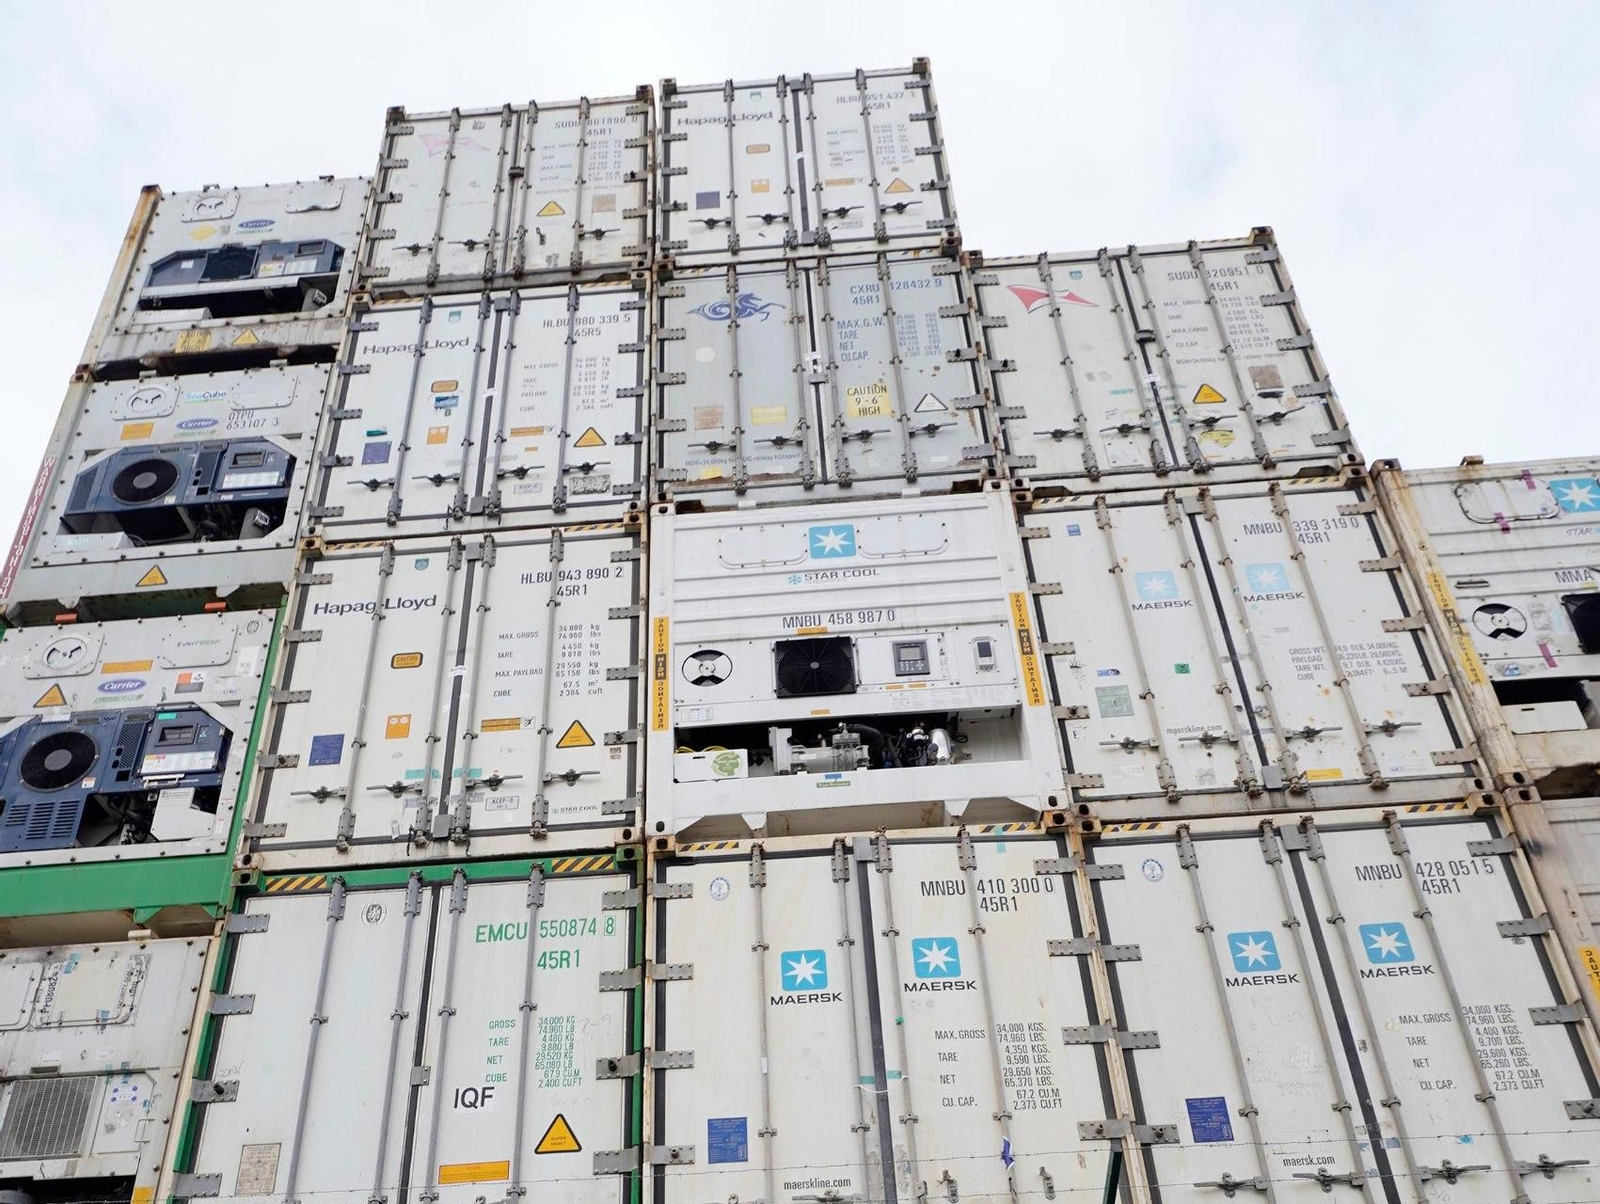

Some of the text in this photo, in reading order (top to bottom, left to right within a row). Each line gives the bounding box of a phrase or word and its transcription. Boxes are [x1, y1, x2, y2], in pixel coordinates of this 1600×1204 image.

[1167, 271, 1198, 281] SUDU
[850, 278, 942, 295] CXRU 128432 9
[1209, 281, 1240, 292] 45R1
[852, 295, 880, 305] 45R1
[543, 318, 570, 328] HLBU
[839, 330, 858, 340] TARE
[839, 341, 854, 351] NET
[847, 385, 887, 397] CAUTION
[858, 405, 880, 416] HIGH
[181, 420, 214, 428] Carrier
[226, 419, 266, 430] 653107
[1243, 517, 1347, 535] MNBU 339 319
[1298, 531, 1331, 544] 45R1
[521, 566, 623, 584] HLBU 943 890 2
[804, 568, 881, 582] STAR COOL
[556, 584, 587, 597] 45R1
[1243, 591, 1306, 602] MAERSK
[1132, 600, 1193, 611] MAERSK
[782, 609, 895, 630] MNBU 458 987 0
[104, 679, 141, 691] Carrier
[1355, 859, 1494, 881] MNBU 428 051 5
[920, 877, 1054, 896] MNBU 410 300 0
[1422, 878, 1460, 894] 45R1
[980, 896, 1018, 912] 45R1
[475, 917, 615, 943] EMCU 550874 8
[537, 949, 580, 970] 45R1
[1360, 964, 1435, 979] MAERSK
[1226, 972, 1300, 988] MAERSK
[904, 980, 977, 992] MAERSK
[770, 991, 843, 1006] MAERSK
[489, 1020, 516, 1030] GROSS
[566, 1016, 576, 1024] KG
[565, 1025, 575, 1033] LB
[958, 1029, 986, 1039] GROSS
[488, 1037, 510, 1047] TARE
[565, 1033, 575, 1042] KG
[1406, 1036, 1428, 1046] TARE
[564, 1042, 574, 1051] LB
[487, 1055, 504, 1065] NET
[564, 1051, 574, 1060] KG
[938, 1052, 958, 1062] TARE
[563, 1060, 573, 1069] LB
[1412, 1058, 1430, 1068] NET
[485, 1073, 508, 1083] CUBE
[940, 1074, 956, 1085] NET
[1495, 1069, 1514, 1080] 67.2
[453, 1086, 495, 1109] IQF
[1016, 1088, 1060, 1099] 67.2 CU.M
[1040, 1098, 1062, 1109] CU.FT
[1282, 1152, 1335, 1167] maersk.com
[783, 1177, 851, 1190] maerskline.com
